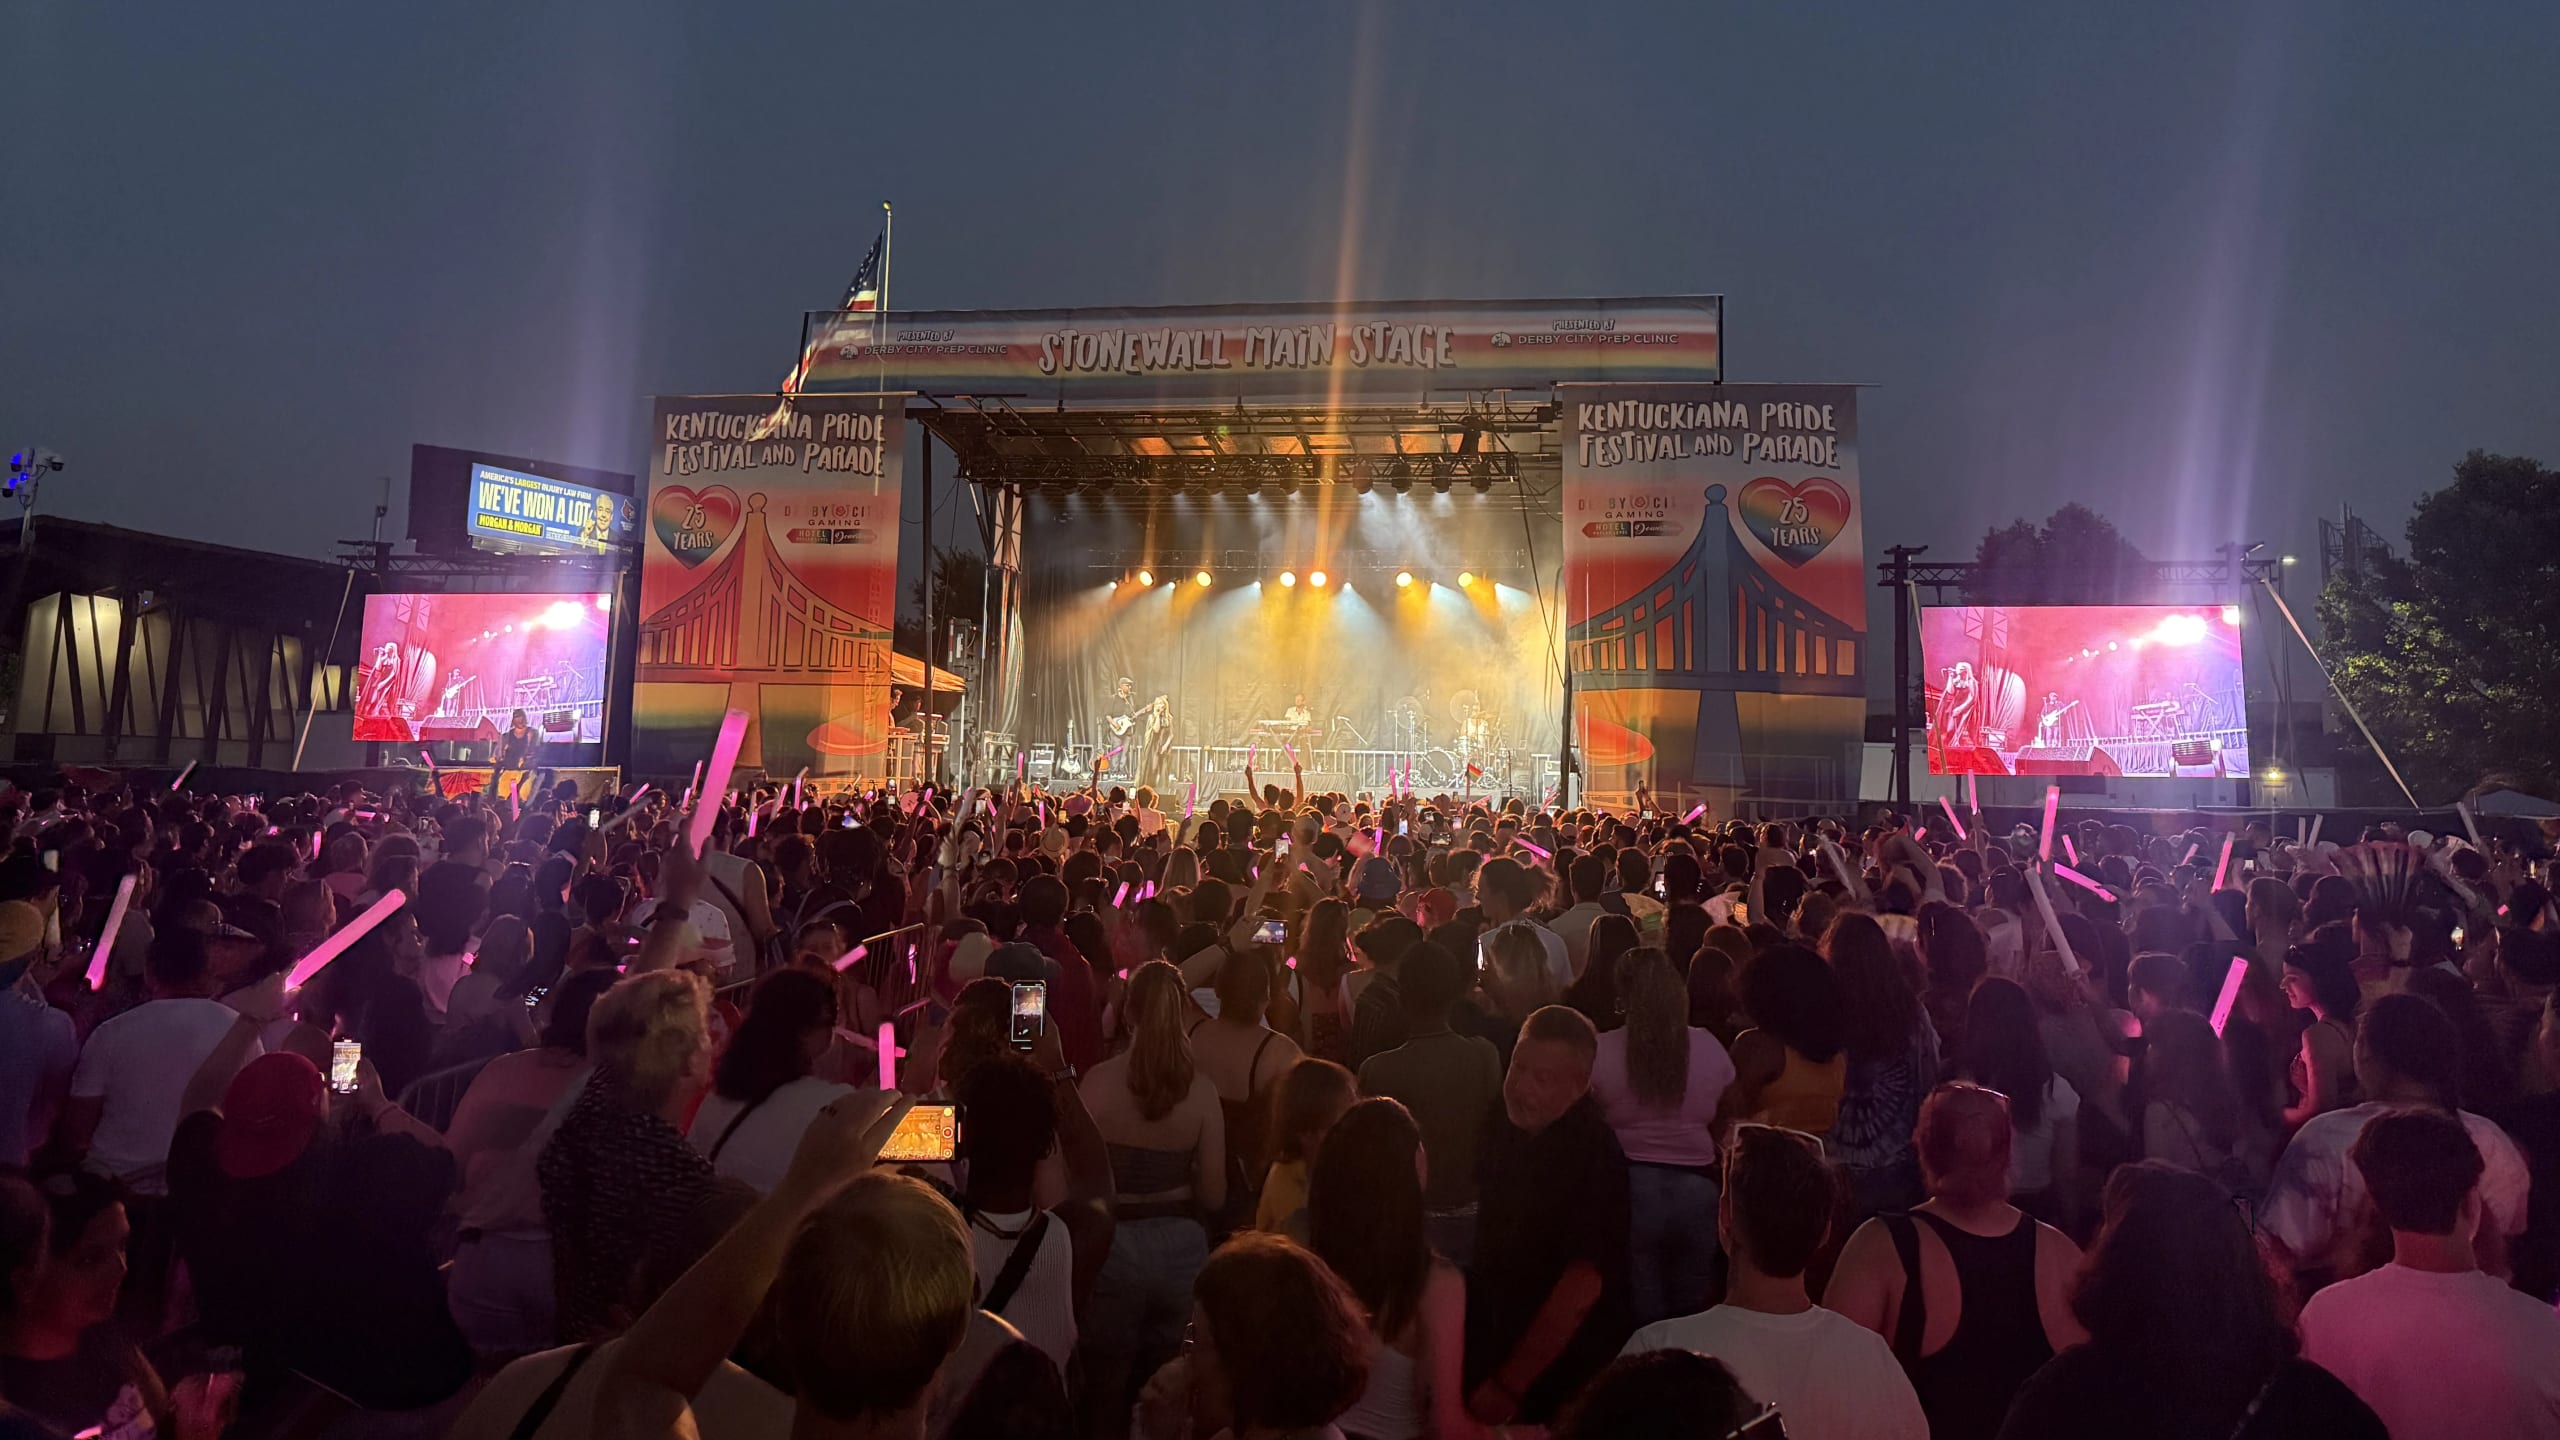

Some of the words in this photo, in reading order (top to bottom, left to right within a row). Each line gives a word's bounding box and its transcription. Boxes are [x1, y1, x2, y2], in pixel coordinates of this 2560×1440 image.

[864, 345, 905, 355] DERBY
[905, 344, 933, 354] CITY
[968, 344, 1008, 354] CLINIC
[1039, 327, 1231, 375] STONEWALL
[1349, 320, 1457, 370] STAGE
[1518, 335, 1560, 345] DERBY
[1565, 334, 1595, 344] CITY
[1634, 334, 1680, 344] CLINIC
[762, 443, 796, 466] AND
[802, 442, 885, 477] PARADE
[1694, 433, 1733, 457] AND
[1743, 432, 1841, 469] PARADE
[479, 470, 514, 485] AMERICA'S
[514, 478, 542, 490] LARGEST
[563, 486, 578, 497] LAW
[479, 481, 521, 516] WE'VE
[523, 491, 555, 522] WON
[556, 497, 567, 524] A
[1605, 510, 1664, 519] GAMING
[1780, 496, 1809, 525] 25
[479, 513, 507, 529] MORGAN
[514, 519, 542, 536] MORGAN
[684, 503, 706, 530] 25
[673, 530, 714, 551] YEARS
[1771, 526, 1821, 548] YEARS
